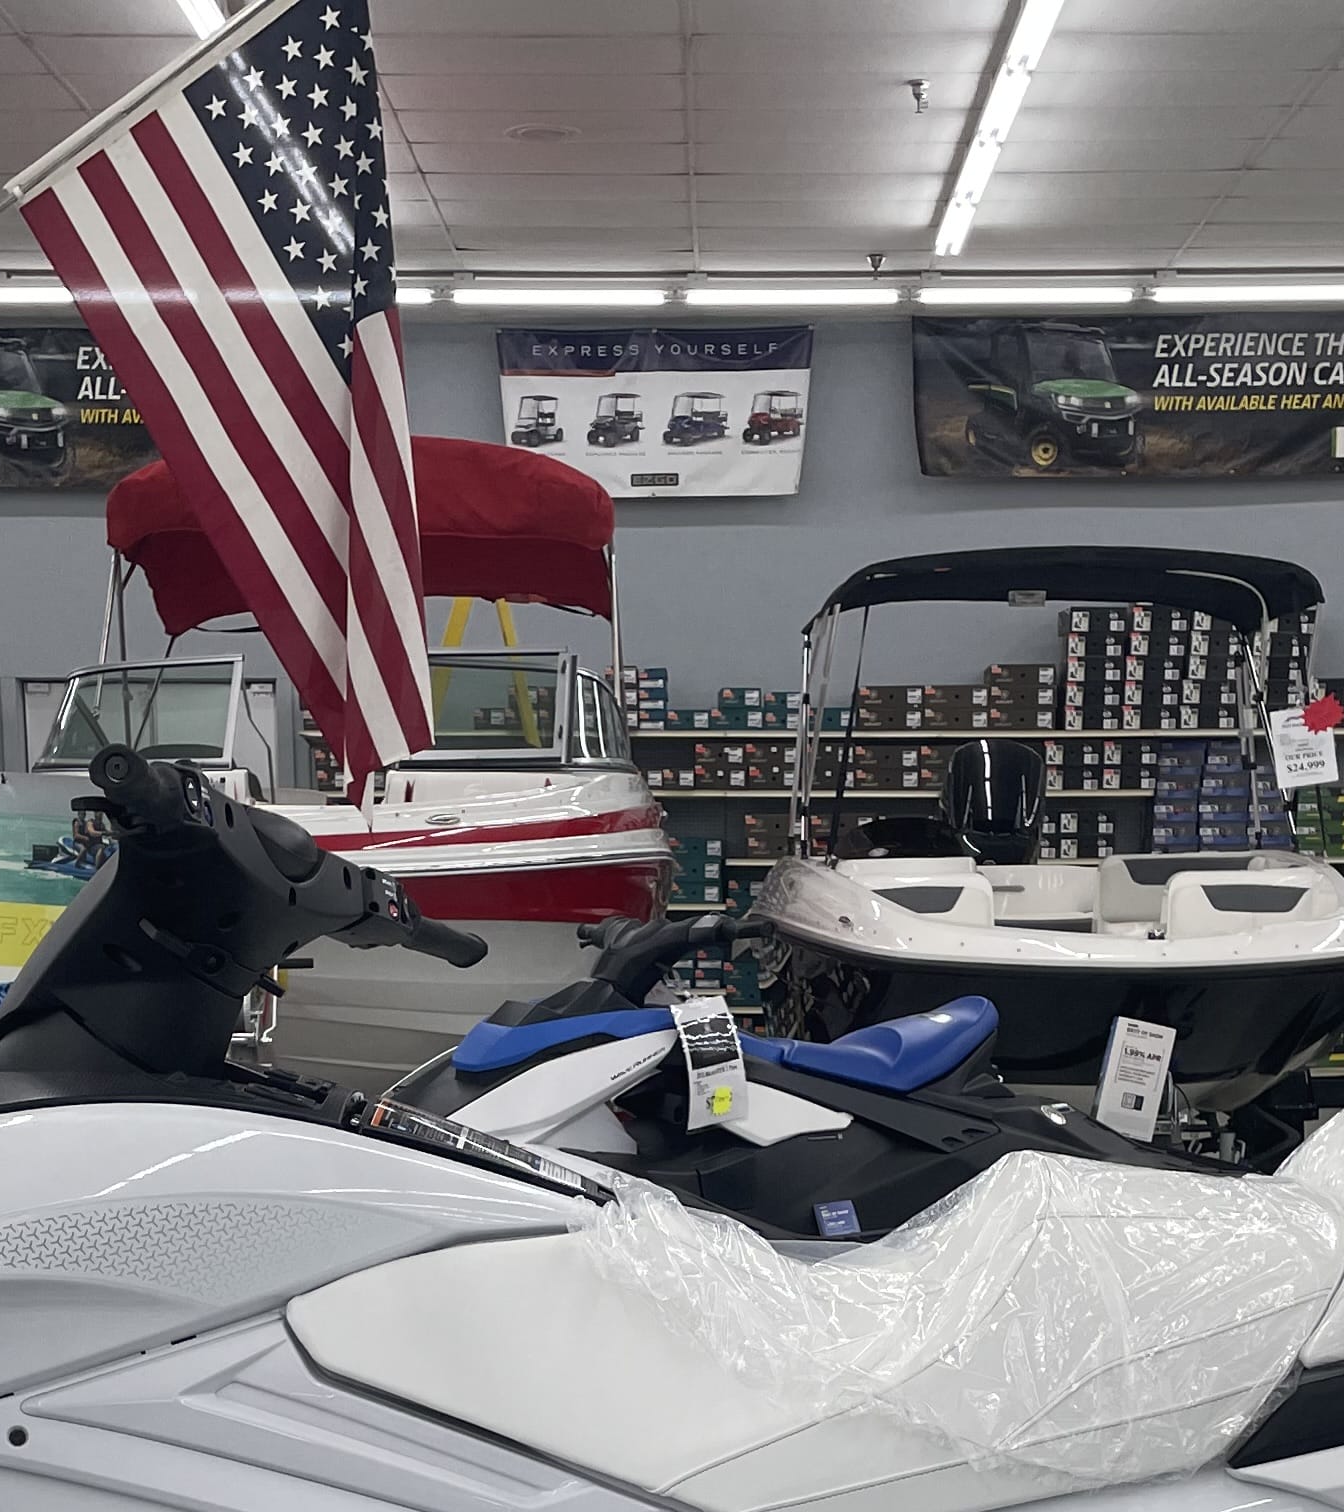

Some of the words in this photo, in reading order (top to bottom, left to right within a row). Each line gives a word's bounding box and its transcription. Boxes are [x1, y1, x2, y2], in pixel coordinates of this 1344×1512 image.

[532, 343, 640, 357] EXPRESS
[655, 342, 780, 356] YOURSELF
[1155, 333, 1308, 358] EXPERIENCE
[1153, 362, 1308, 387] ALL-SEASON
[1155, 396, 1194, 411] WITH
[1196, 394, 1276, 411] AVAILABLE
[1281, 394, 1316, 410] HEAT
[80, 408, 119, 424] WITH
